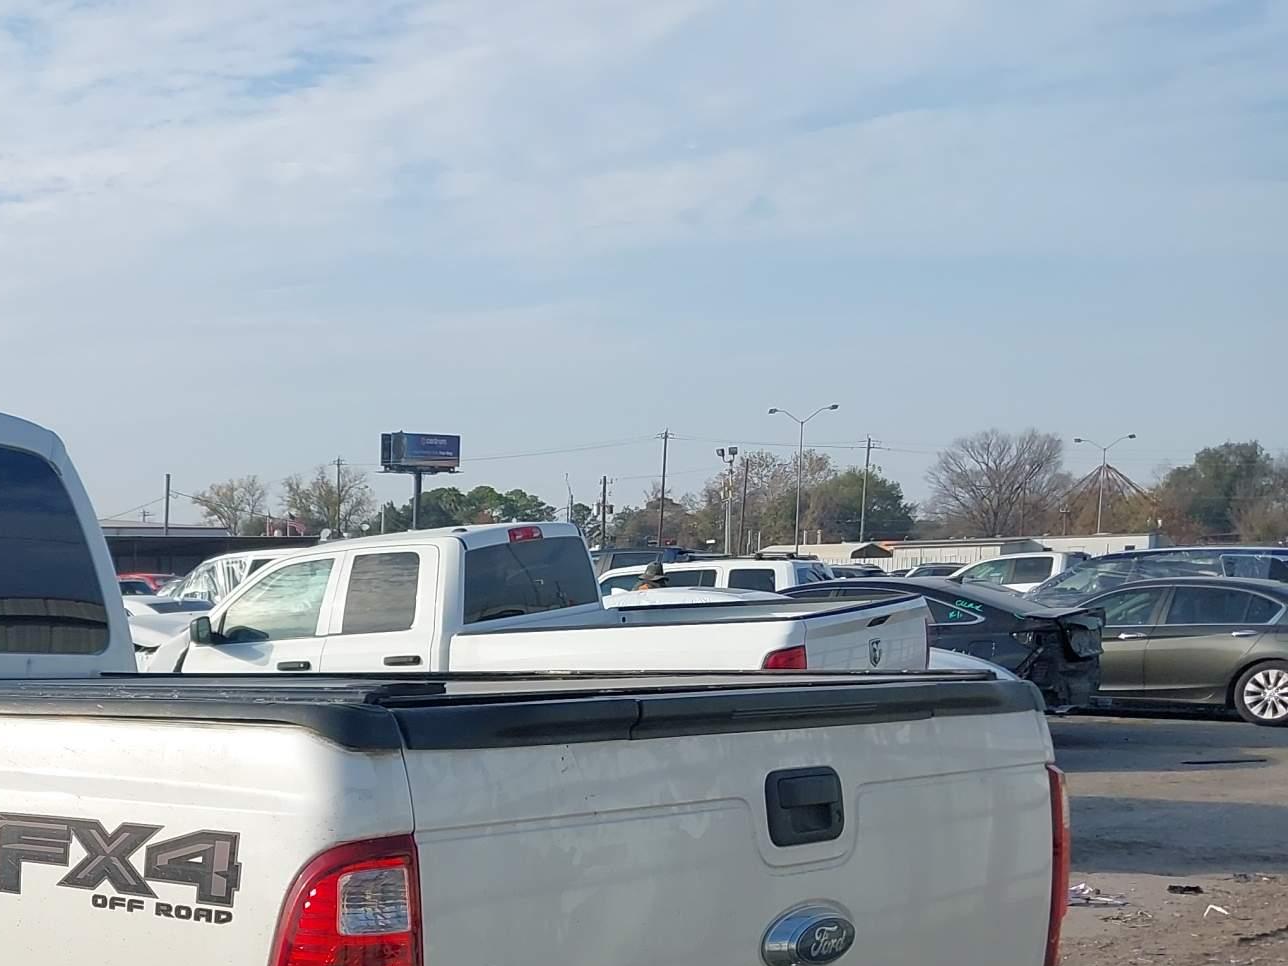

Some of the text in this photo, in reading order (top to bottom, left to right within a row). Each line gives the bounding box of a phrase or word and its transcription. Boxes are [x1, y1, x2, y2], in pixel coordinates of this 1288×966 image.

[91, 893, 234, 925] OFF ROAD
[810, 924, 847, 957] Ford
